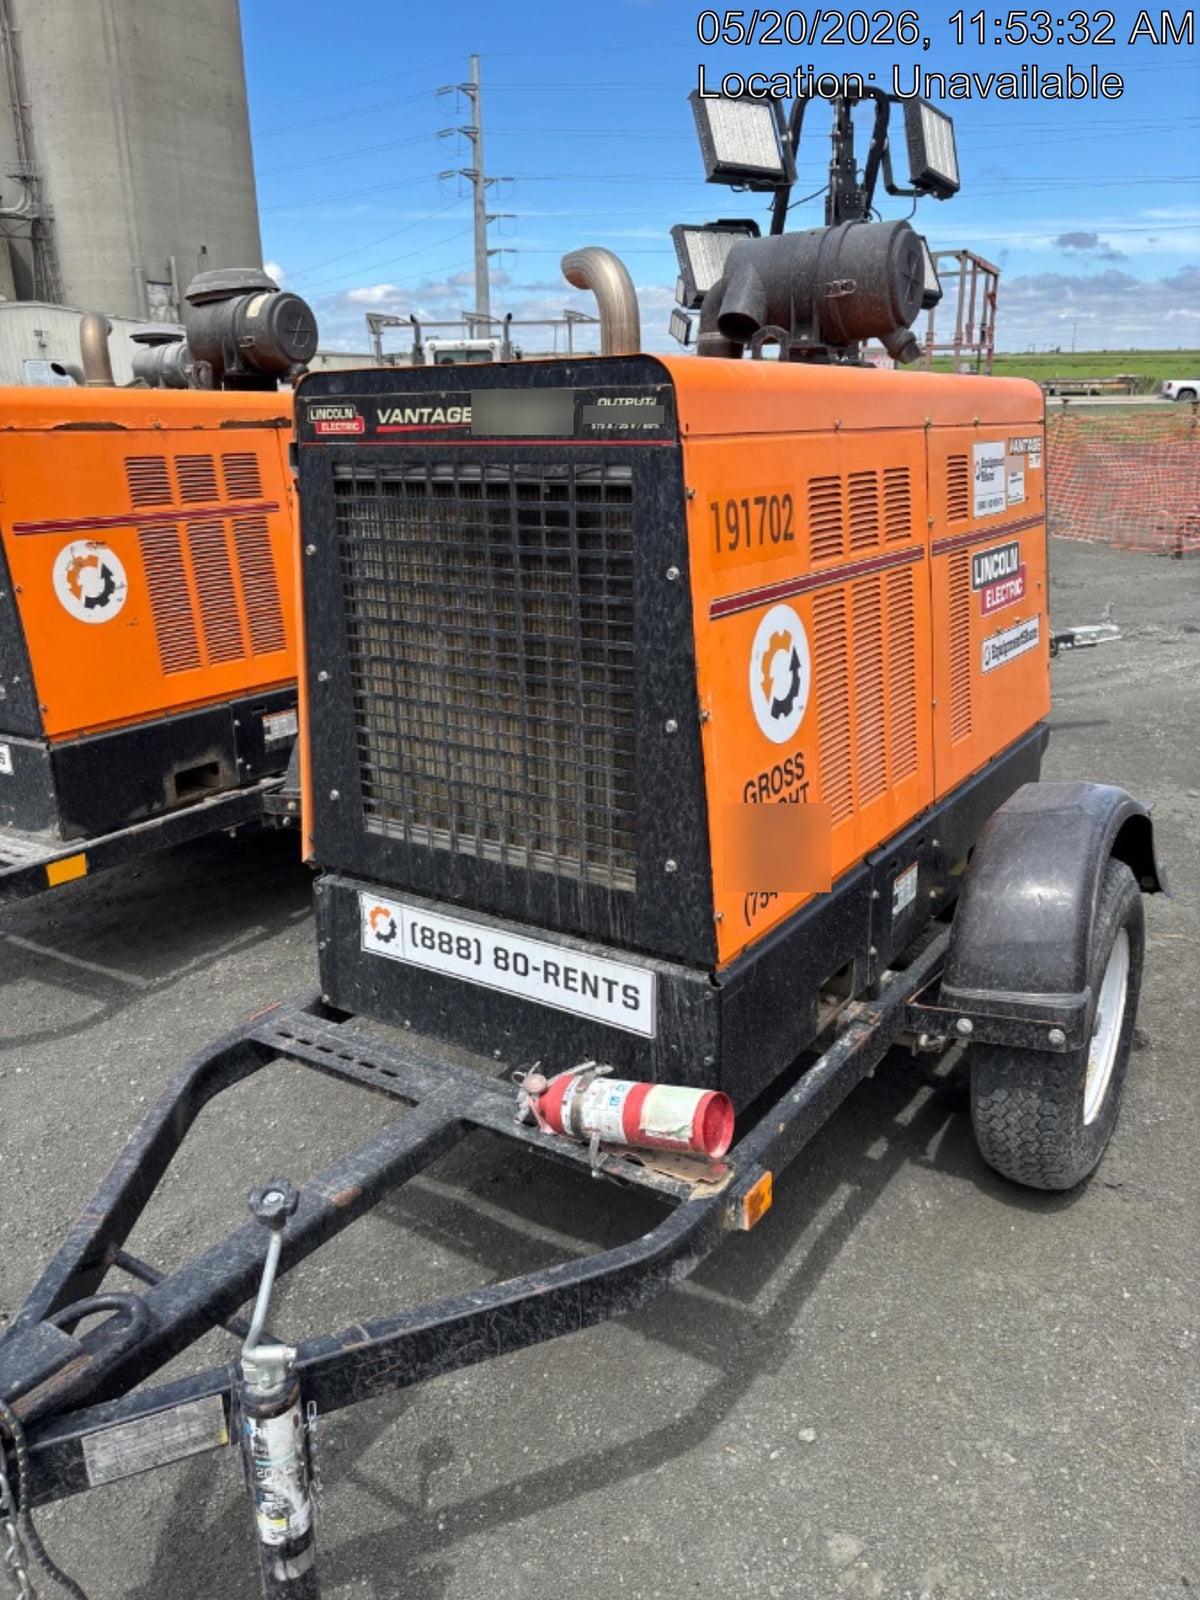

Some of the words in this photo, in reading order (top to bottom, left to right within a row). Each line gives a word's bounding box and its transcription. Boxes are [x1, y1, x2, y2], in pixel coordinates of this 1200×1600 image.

[310, 408, 353, 420] LINCOLN
[377, 406, 471, 424] VANTAGE
[711, 494, 794, 553] 191702
[974, 547, 1018, 585] LINCOLN
[985, 578, 1023, 608] ELECTRIC
[744, 752, 805, 803] GROSS
[410, 921, 482, 966] (888)
[493, 946, 641, 1011] 80-RENTS
